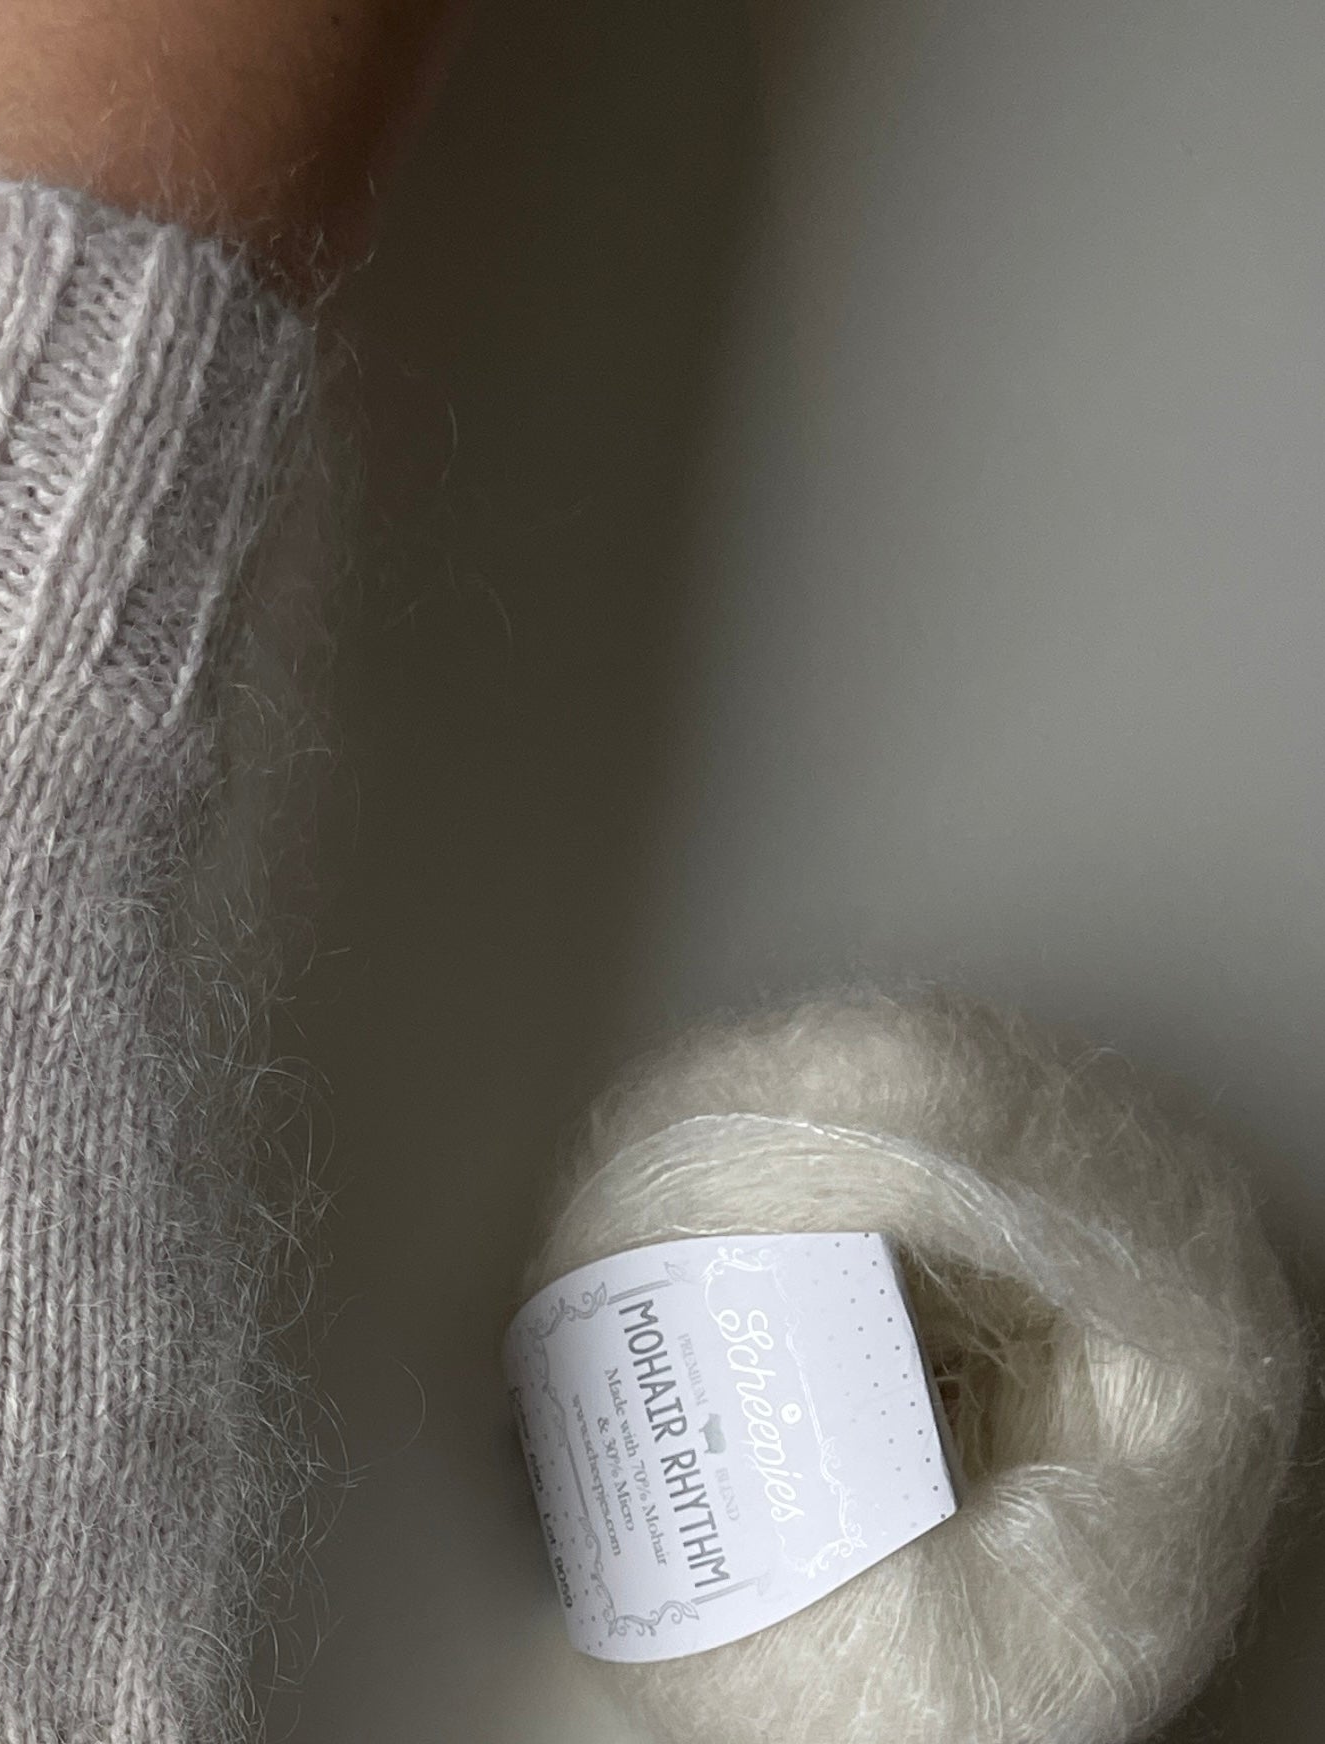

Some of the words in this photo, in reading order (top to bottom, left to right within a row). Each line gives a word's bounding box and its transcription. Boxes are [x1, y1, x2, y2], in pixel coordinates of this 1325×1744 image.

[572, 1394, 622, 1556] www.scheepjes.com
[597, 1416, 610, 1434] &
[602, 1436, 624, 1478] 30%
[604, 1367, 628, 1416] Made
[619, 1419, 640, 1458] with
[631, 1459, 652, 1503] 70%
[642, 1504, 668, 1567] Mohair
[619, 1299, 688, 1443] MOHAIR
[660, 1448, 731, 1588] RHYTHM
[676, 1332, 710, 1407] PREMIUM
[715, 1466, 741, 1522] BLEND
[718, 1309, 804, 1522] Scheepjes
[613, 1480, 635, 1533] Micro
